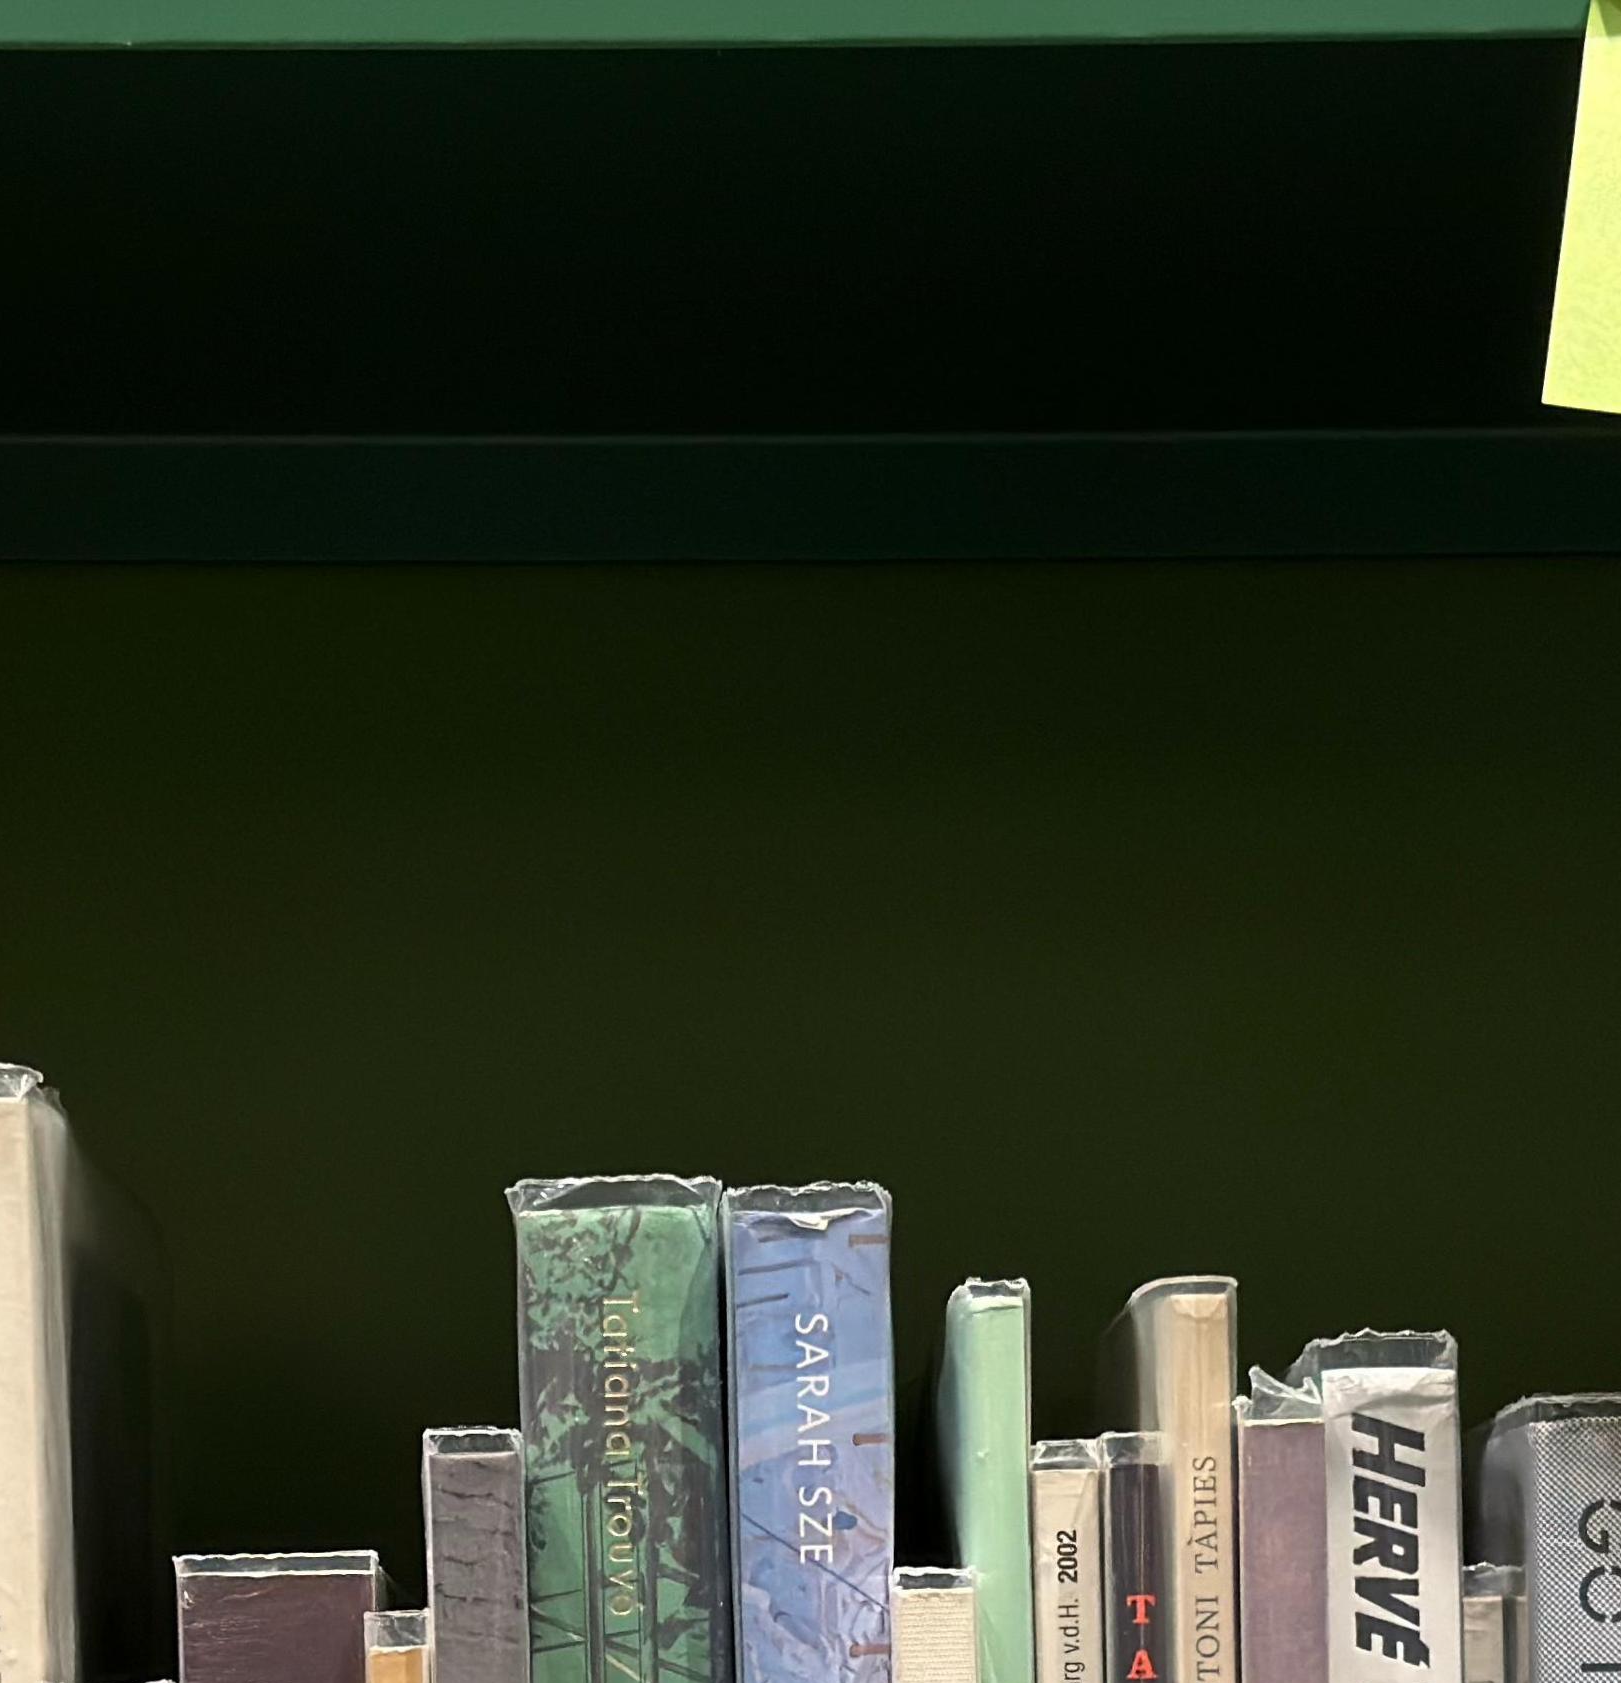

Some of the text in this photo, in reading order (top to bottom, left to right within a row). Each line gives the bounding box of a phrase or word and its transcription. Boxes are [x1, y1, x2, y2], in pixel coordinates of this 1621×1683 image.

[792, 1312, 833, 1565] SARAH SZE
[1186, 1455, 1218, 1574] TÀPIES
[1056, 1529, 1079, 1584] 2002
[1348, 1411, 1430, 1668] HERVÉ
